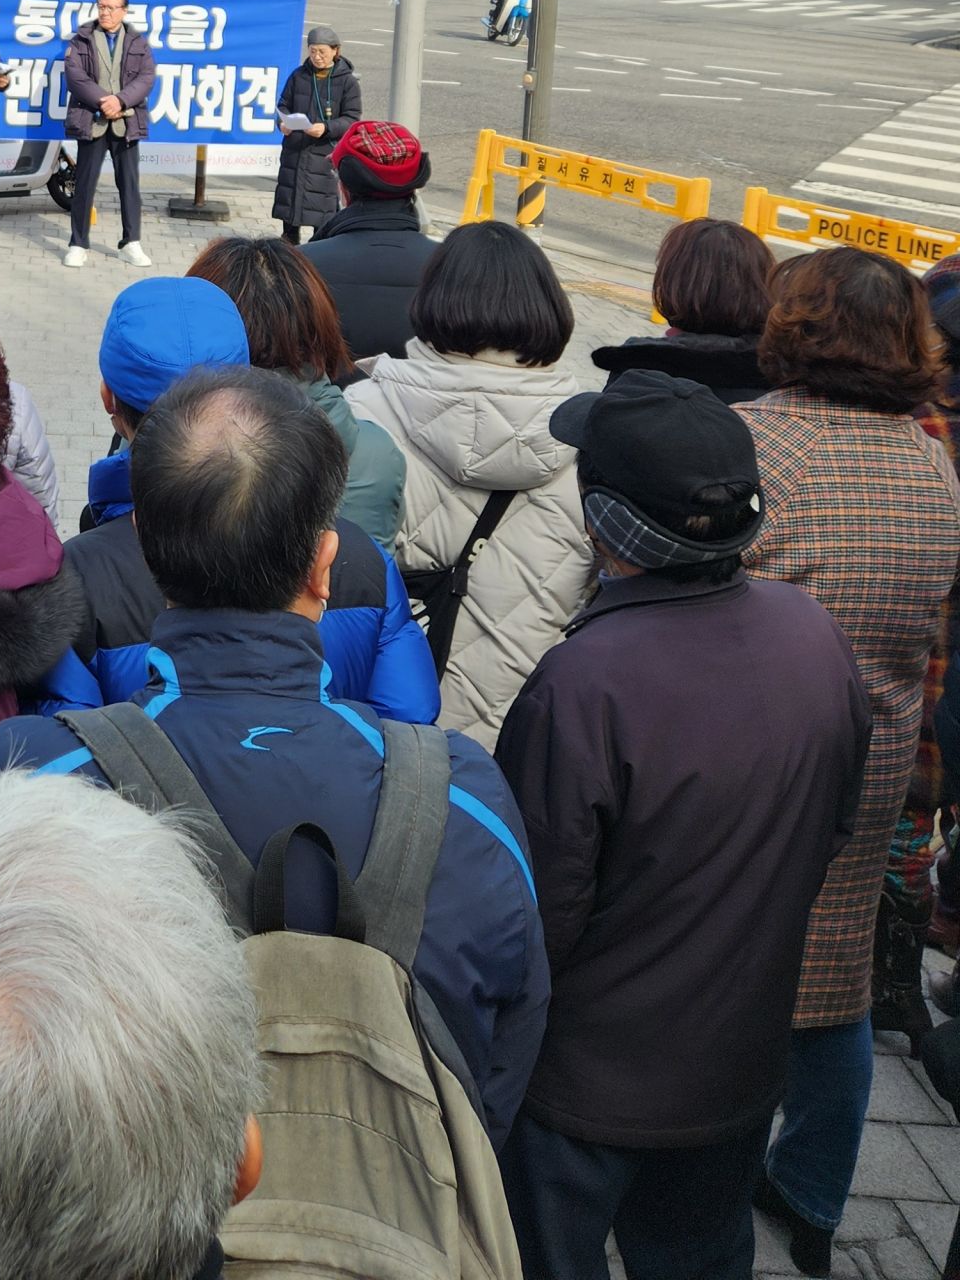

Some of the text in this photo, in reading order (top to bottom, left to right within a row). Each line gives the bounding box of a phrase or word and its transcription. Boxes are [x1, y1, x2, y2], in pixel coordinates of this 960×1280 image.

[149, 63, 280, 134] 자회견
[537, 155, 635, 194] 질서유지선
[818, 218, 944, 261] POLICE LINE
